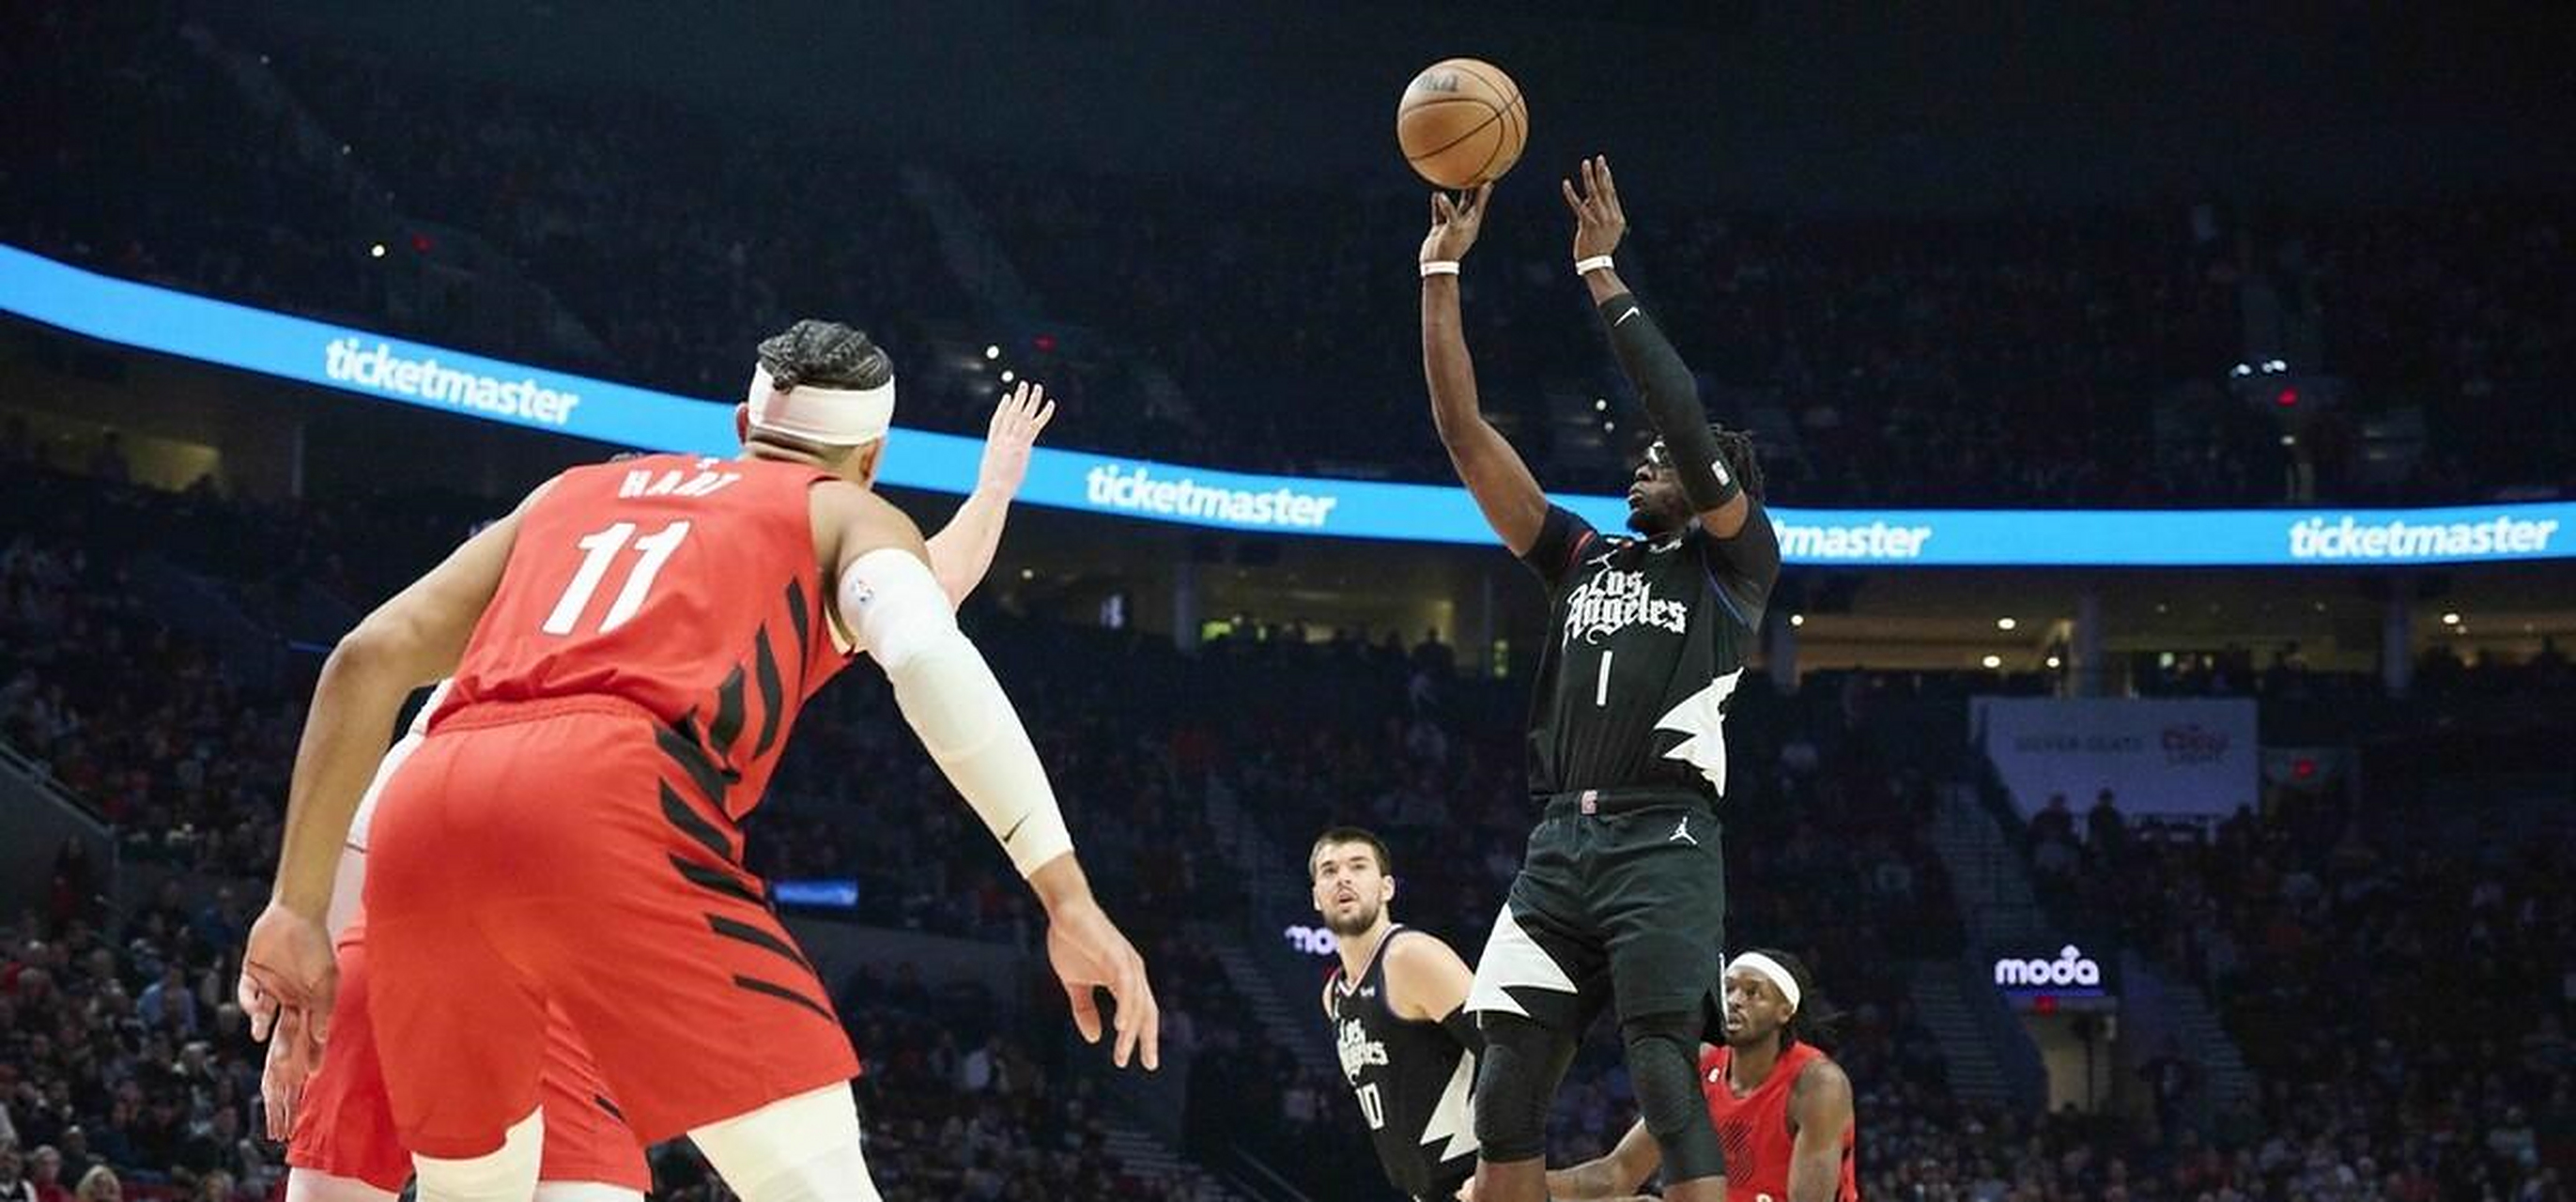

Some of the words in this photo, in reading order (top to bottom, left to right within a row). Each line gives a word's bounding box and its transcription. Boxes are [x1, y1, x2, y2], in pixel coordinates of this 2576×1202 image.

[326, 338, 579, 425] ticketmaster
[1087, 464, 1336, 527] ticketmaster
[2290, 516, 2559, 557] ticketmaster
[541, 521, 690, 635] 11
[1587, 567, 1644, 599] Los
[1562, 582, 1688, 653] Angeles
[1596, 650, 1613, 706] 1
[1285, 925, 1337, 955] mo
[1995, 944, 2100, 985] moda
[1355, 1082, 1385, 1130] 10
